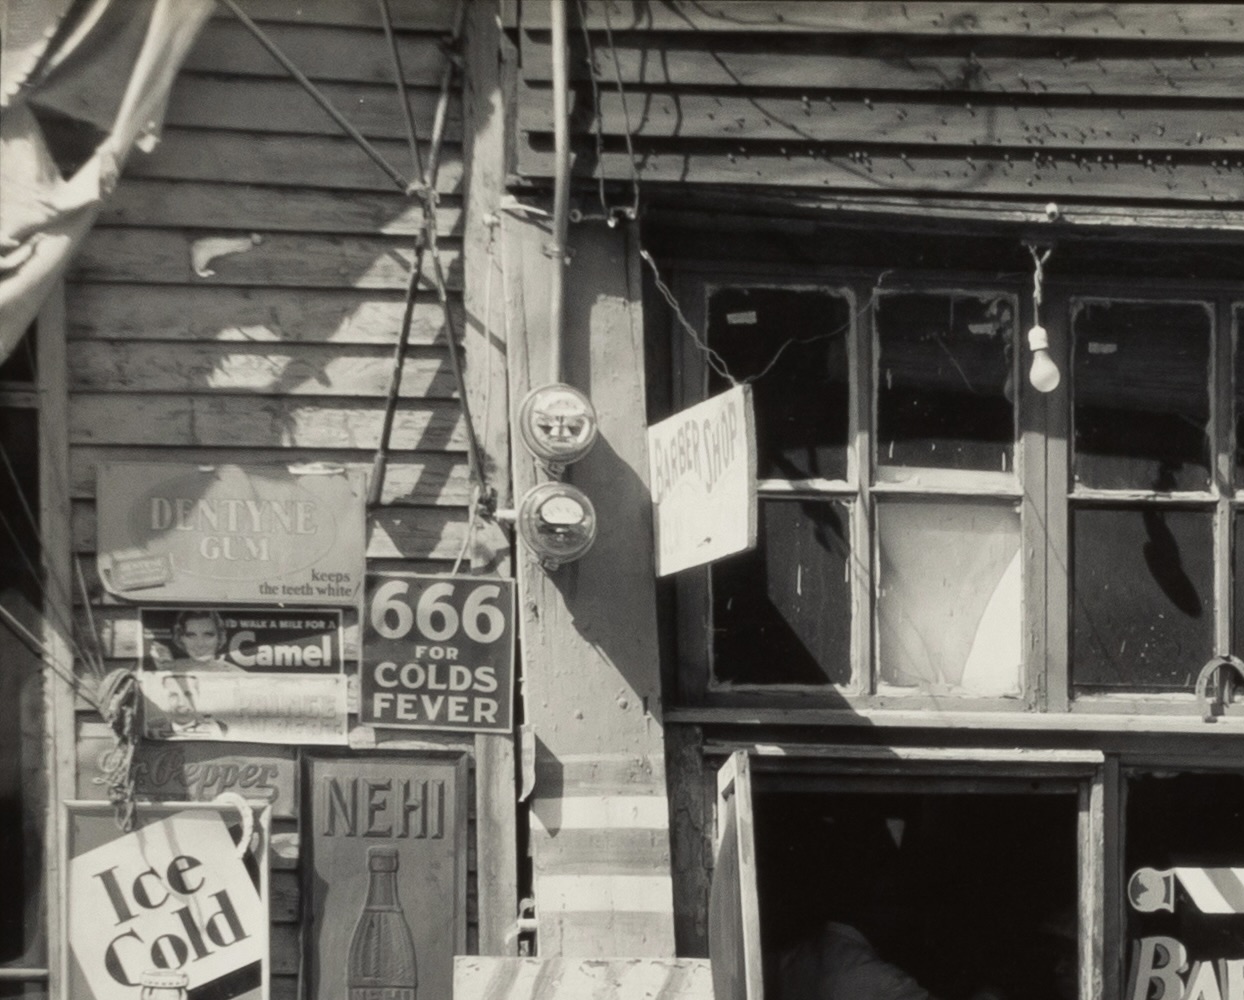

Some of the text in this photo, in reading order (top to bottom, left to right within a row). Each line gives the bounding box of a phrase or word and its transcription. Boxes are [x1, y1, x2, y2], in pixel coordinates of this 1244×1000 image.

[654, 401, 737, 505] BARBER SHOP
[149, 497, 319, 535] DENTYNE
[199, 535, 272, 562] GUM
[259, 583, 280, 596] the
[281, 583, 314, 596] teeth
[311, 569, 351, 585] keeps
[239, 619, 268, 629] WALK
[269, 619, 278, 629] A
[279, 619, 303, 630] MILE
[305, 619, 326, 630] FOR
[370, 580, 505, 644] 666
[228, 630, 332, 667] Camel
[415, 645, 459, 660] FOR
[374, 661, 498, 693] COLDS
[372, 692, 499, 723] FEVER
[150, 748, 280, 804] Pepper
[322, 775, 445, 839] NEHI
[91, 855, 206, 926] Ice
[104, 888, 252, 987] Cold
